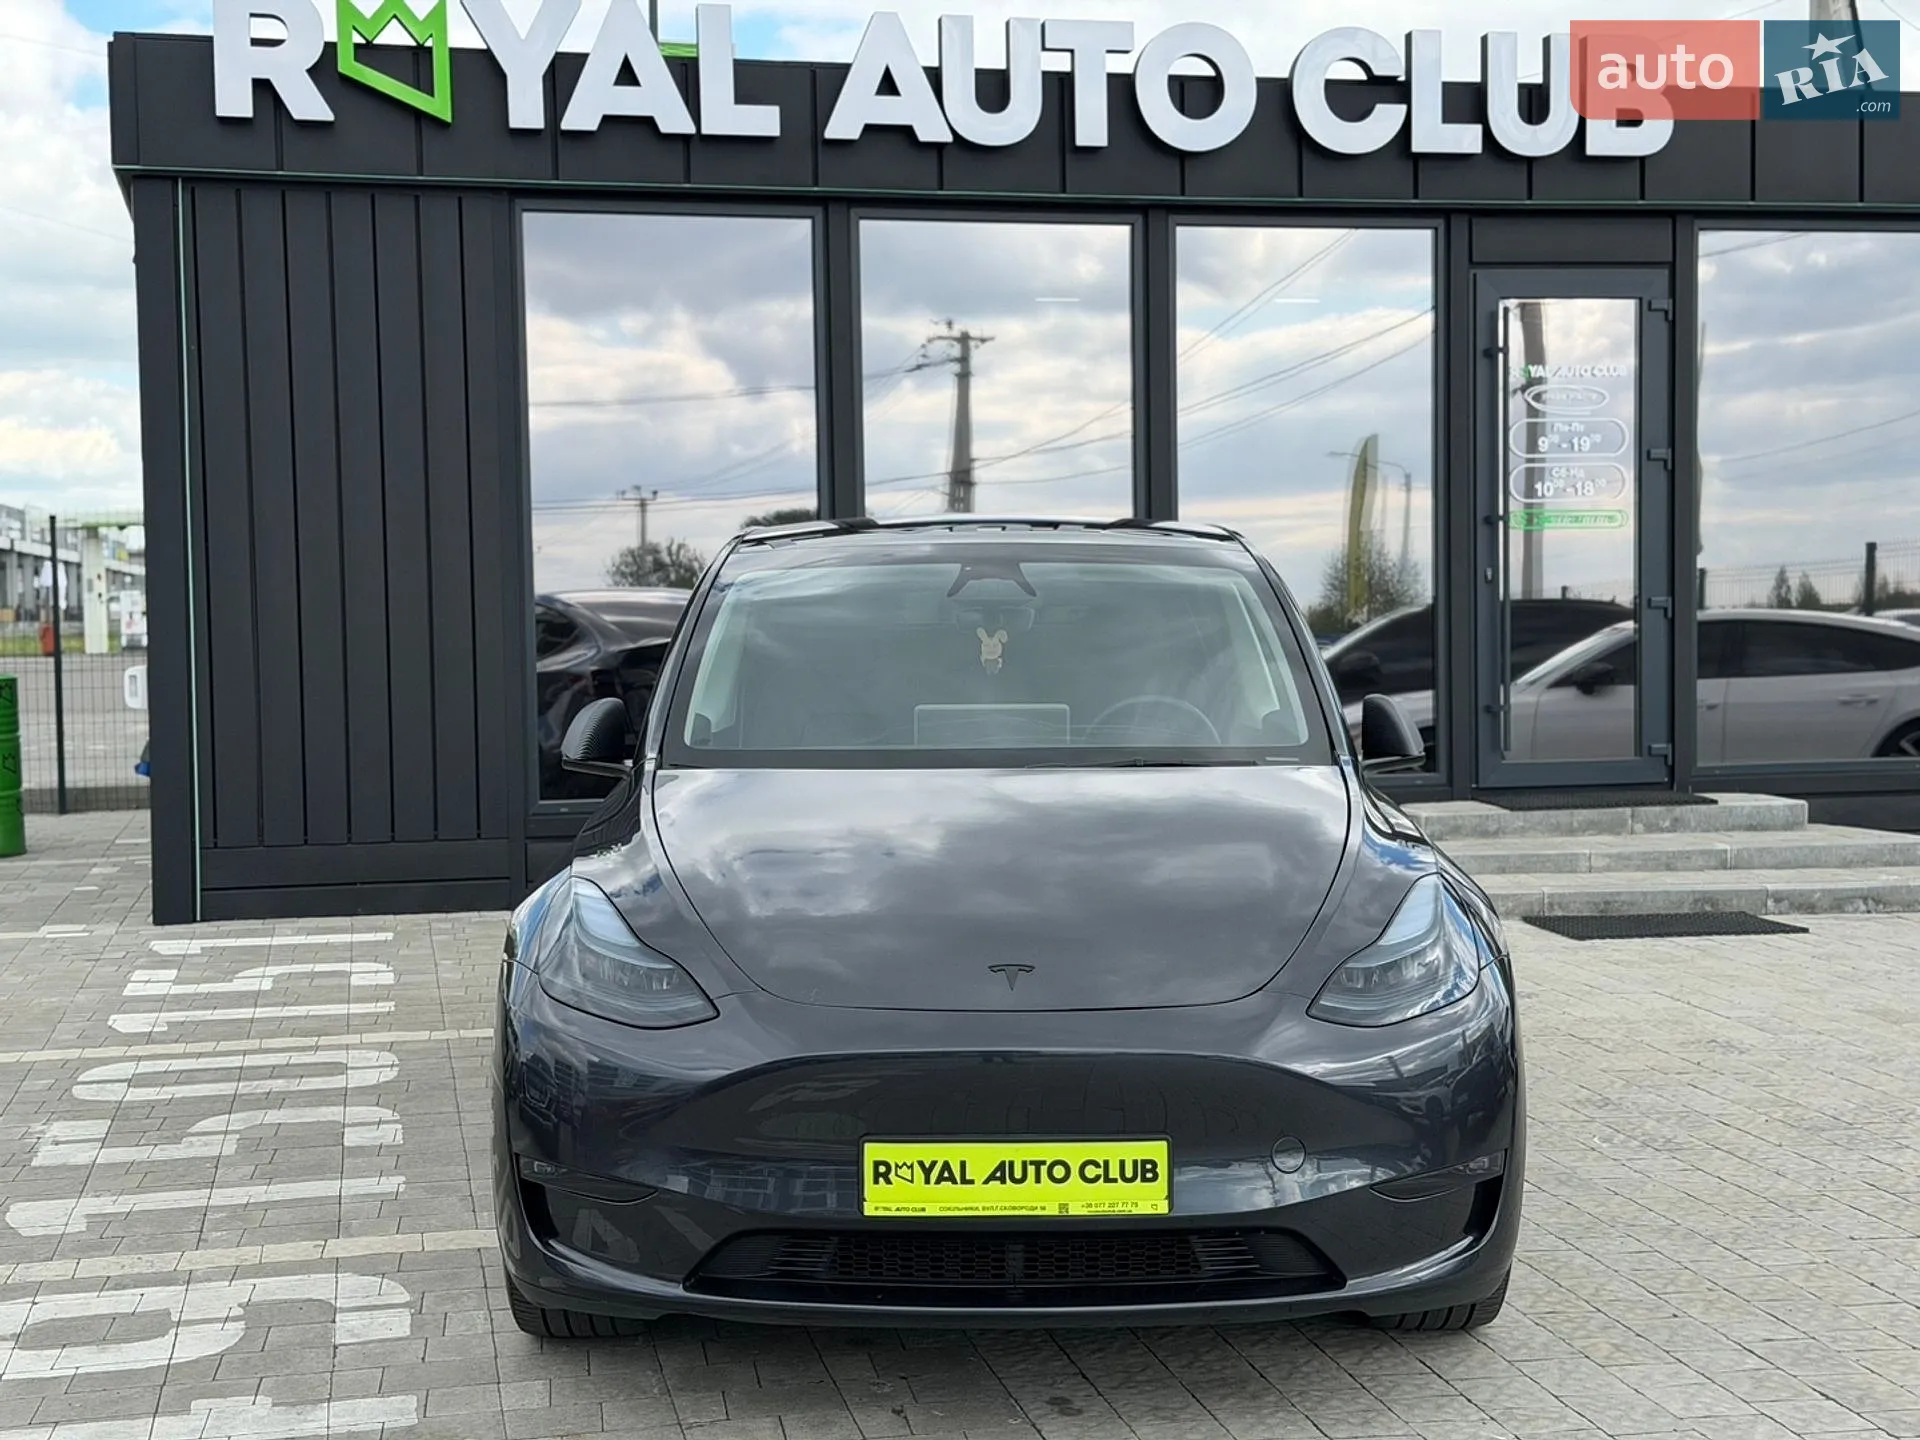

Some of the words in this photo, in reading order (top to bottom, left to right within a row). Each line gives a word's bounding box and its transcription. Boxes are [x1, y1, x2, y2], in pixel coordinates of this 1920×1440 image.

[823, 11, 1257, 153] AUTO
[1289, 25, 1674, 158] CLUB
[982, 1159, 1072, 1185] AUTO
[1078, 1158, 1160, 1185] CLUB
